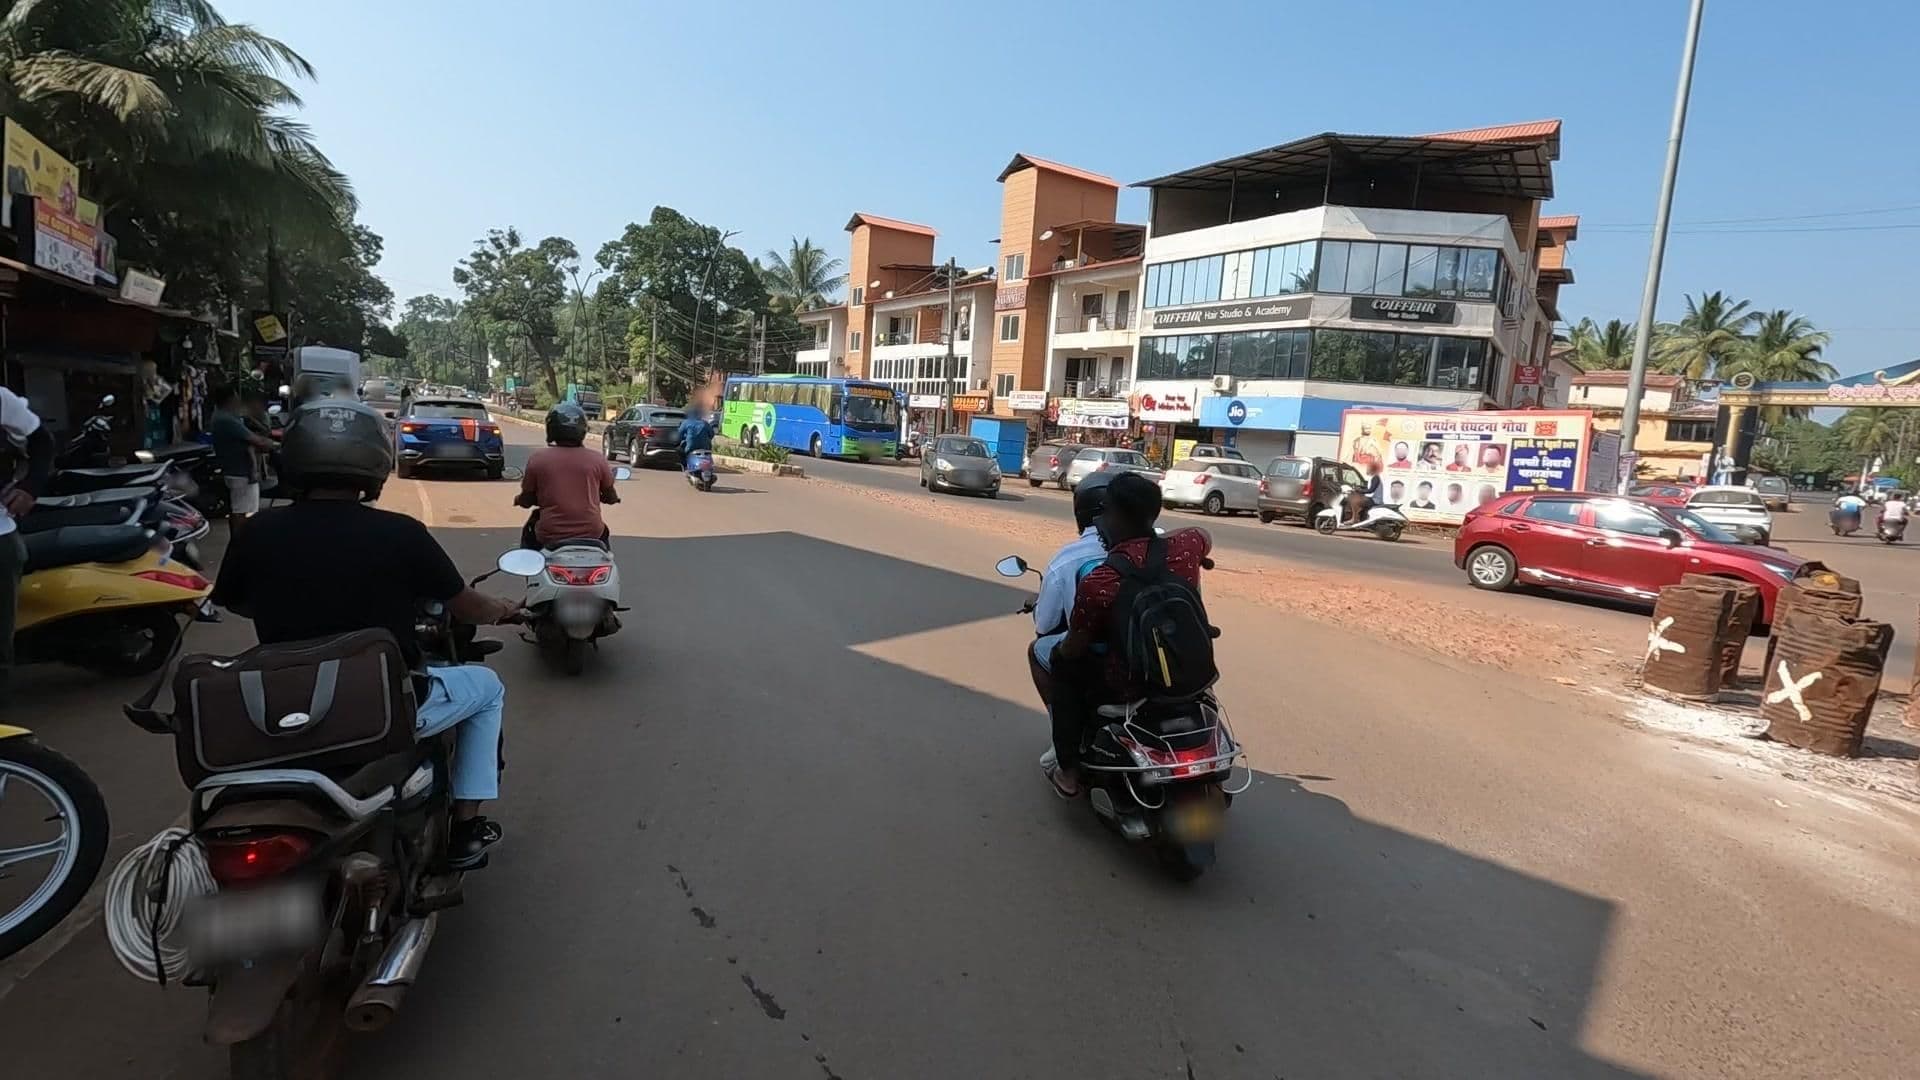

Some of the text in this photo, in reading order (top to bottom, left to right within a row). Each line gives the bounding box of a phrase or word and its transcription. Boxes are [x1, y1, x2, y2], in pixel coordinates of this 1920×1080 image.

[1371, 299, 1437, 314] COIFFEUR
[1153, 304, 1292, 324] COIFFEUR Hair Studio & Academy
[1228, 406, 1244, 417] Jio
[1424, 420, 1456, 431] समर्थन
[1461, 421, 1498, 433] संघटना
[1502, 420, 1528, 433] गोवा
